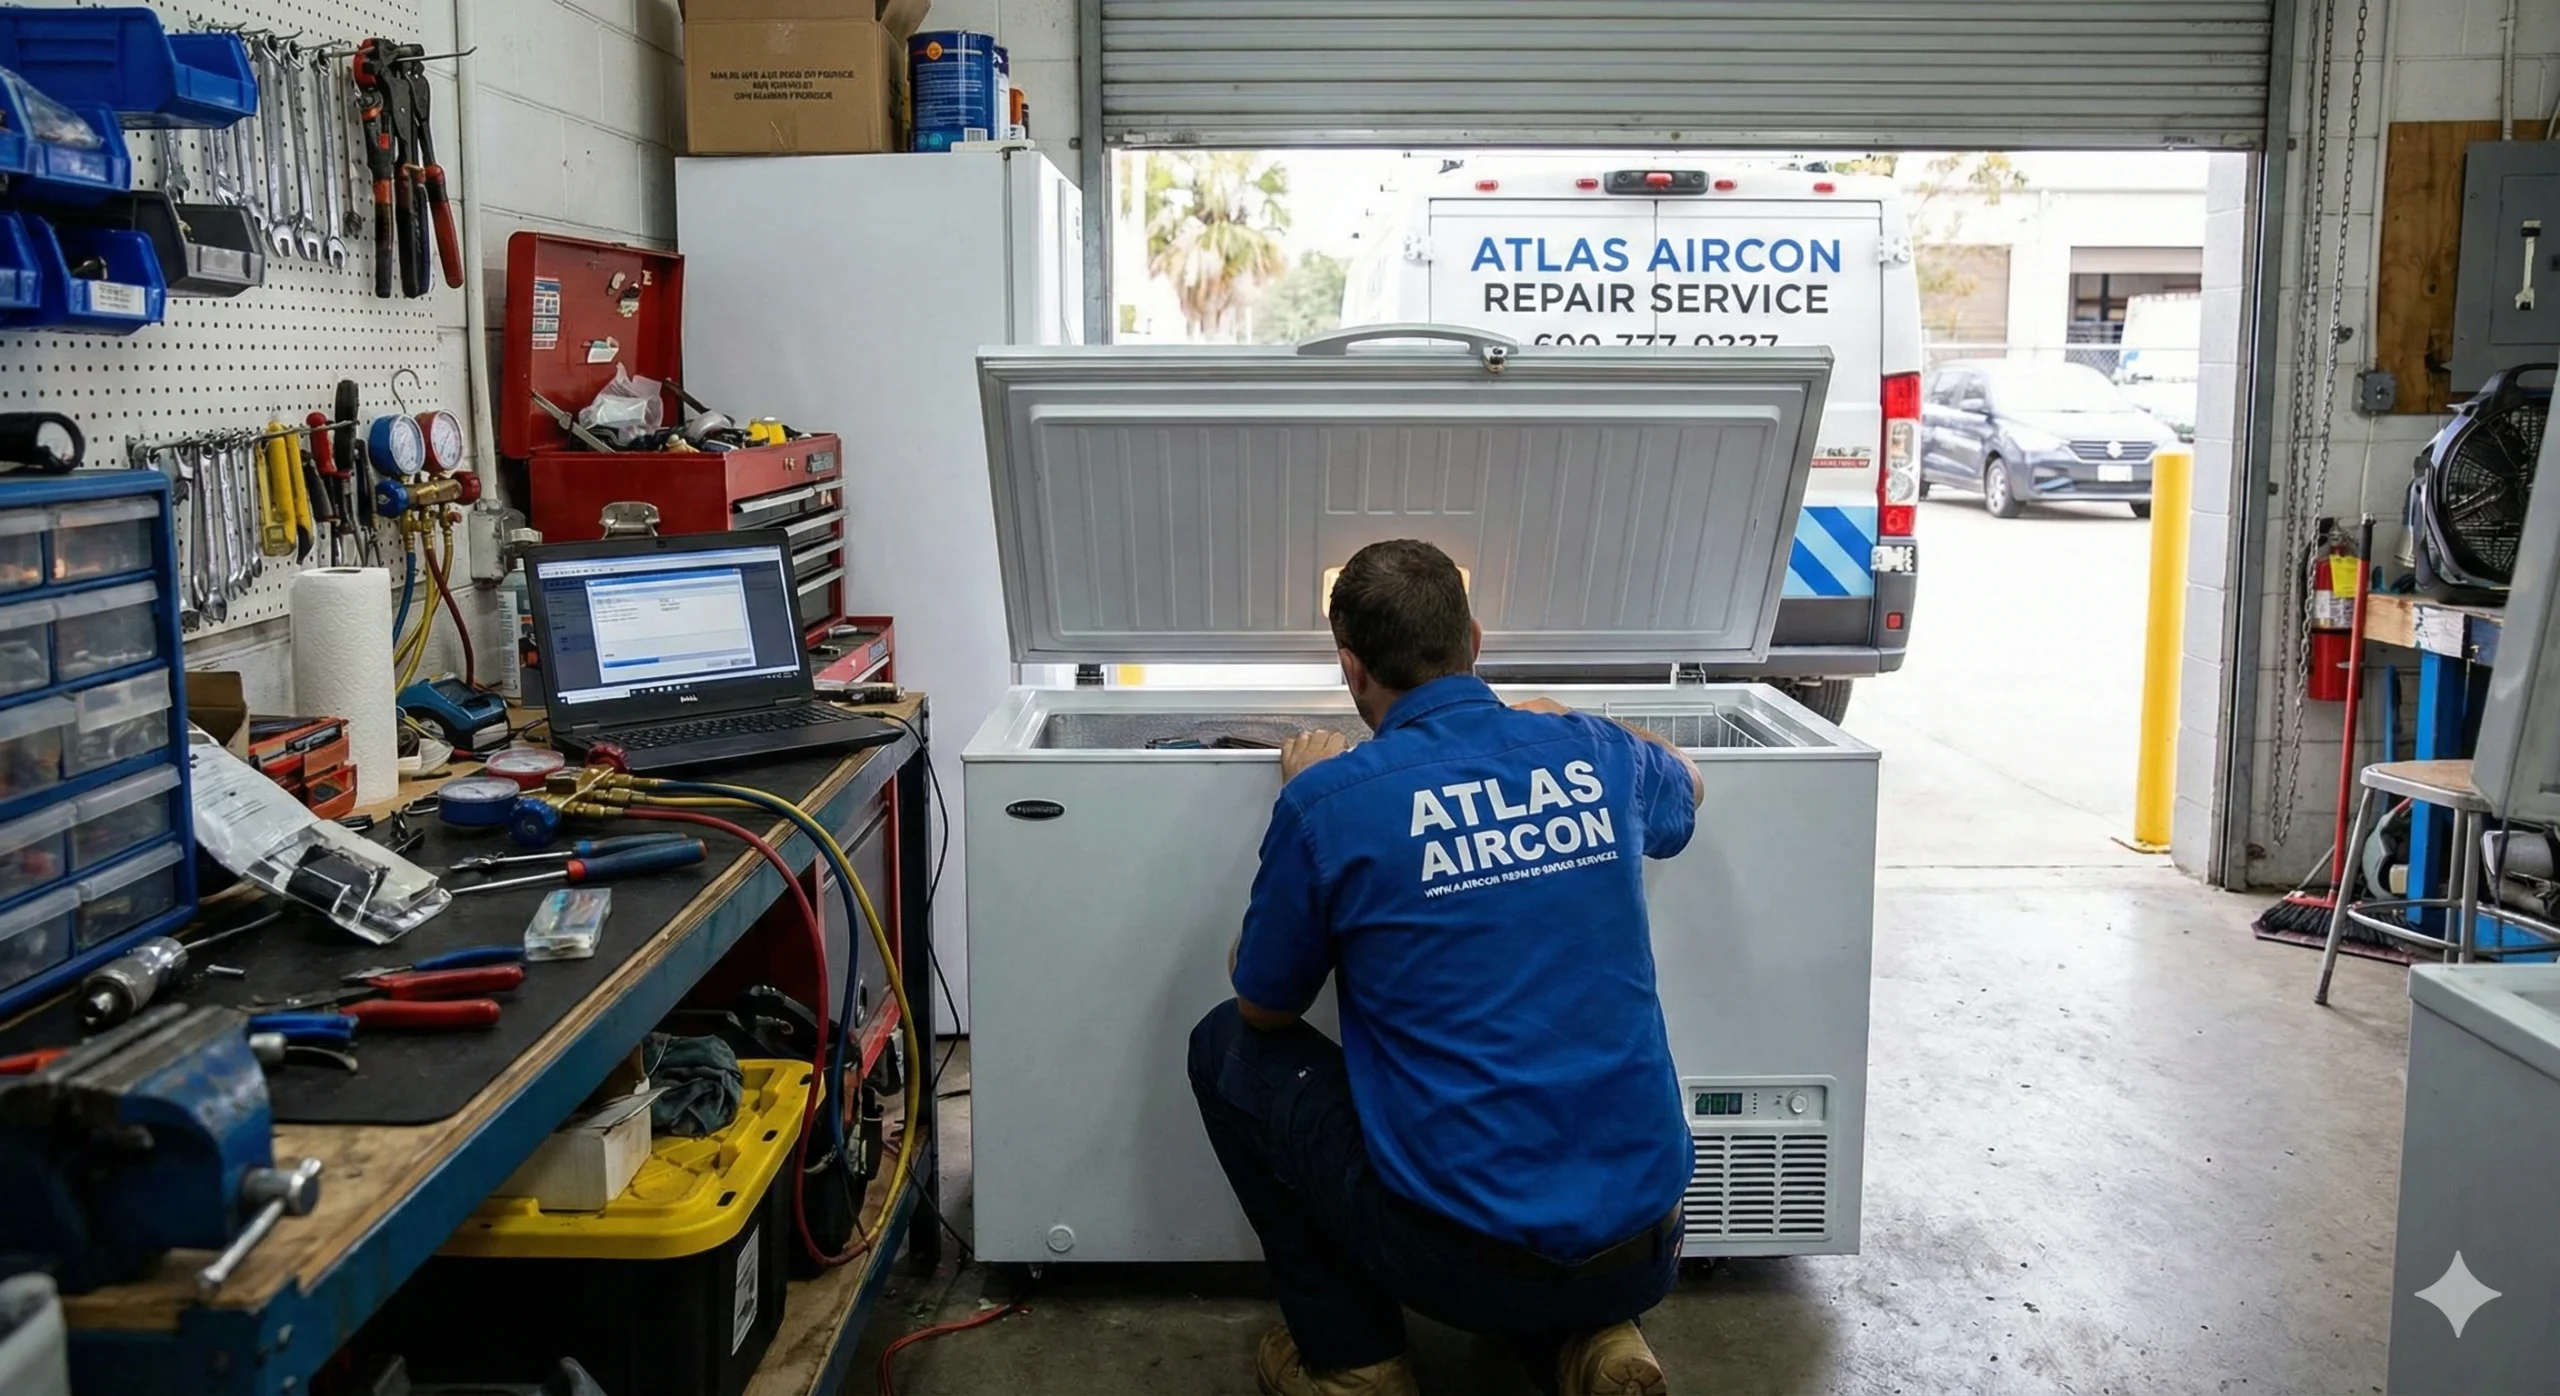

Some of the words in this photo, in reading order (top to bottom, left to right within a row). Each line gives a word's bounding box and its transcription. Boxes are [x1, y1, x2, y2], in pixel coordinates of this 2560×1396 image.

[1471, 237, 1629, 273] ATLAS
[1647, 237, 1841, 273] AIRCON
[1484, 283, 1635, 313] REPAIR
[1650, 283, 1829, 314] SERVICE
[1410, 760, 1604, 837] ATLAS
[1421, 807, 1616, 882] AIRCON
